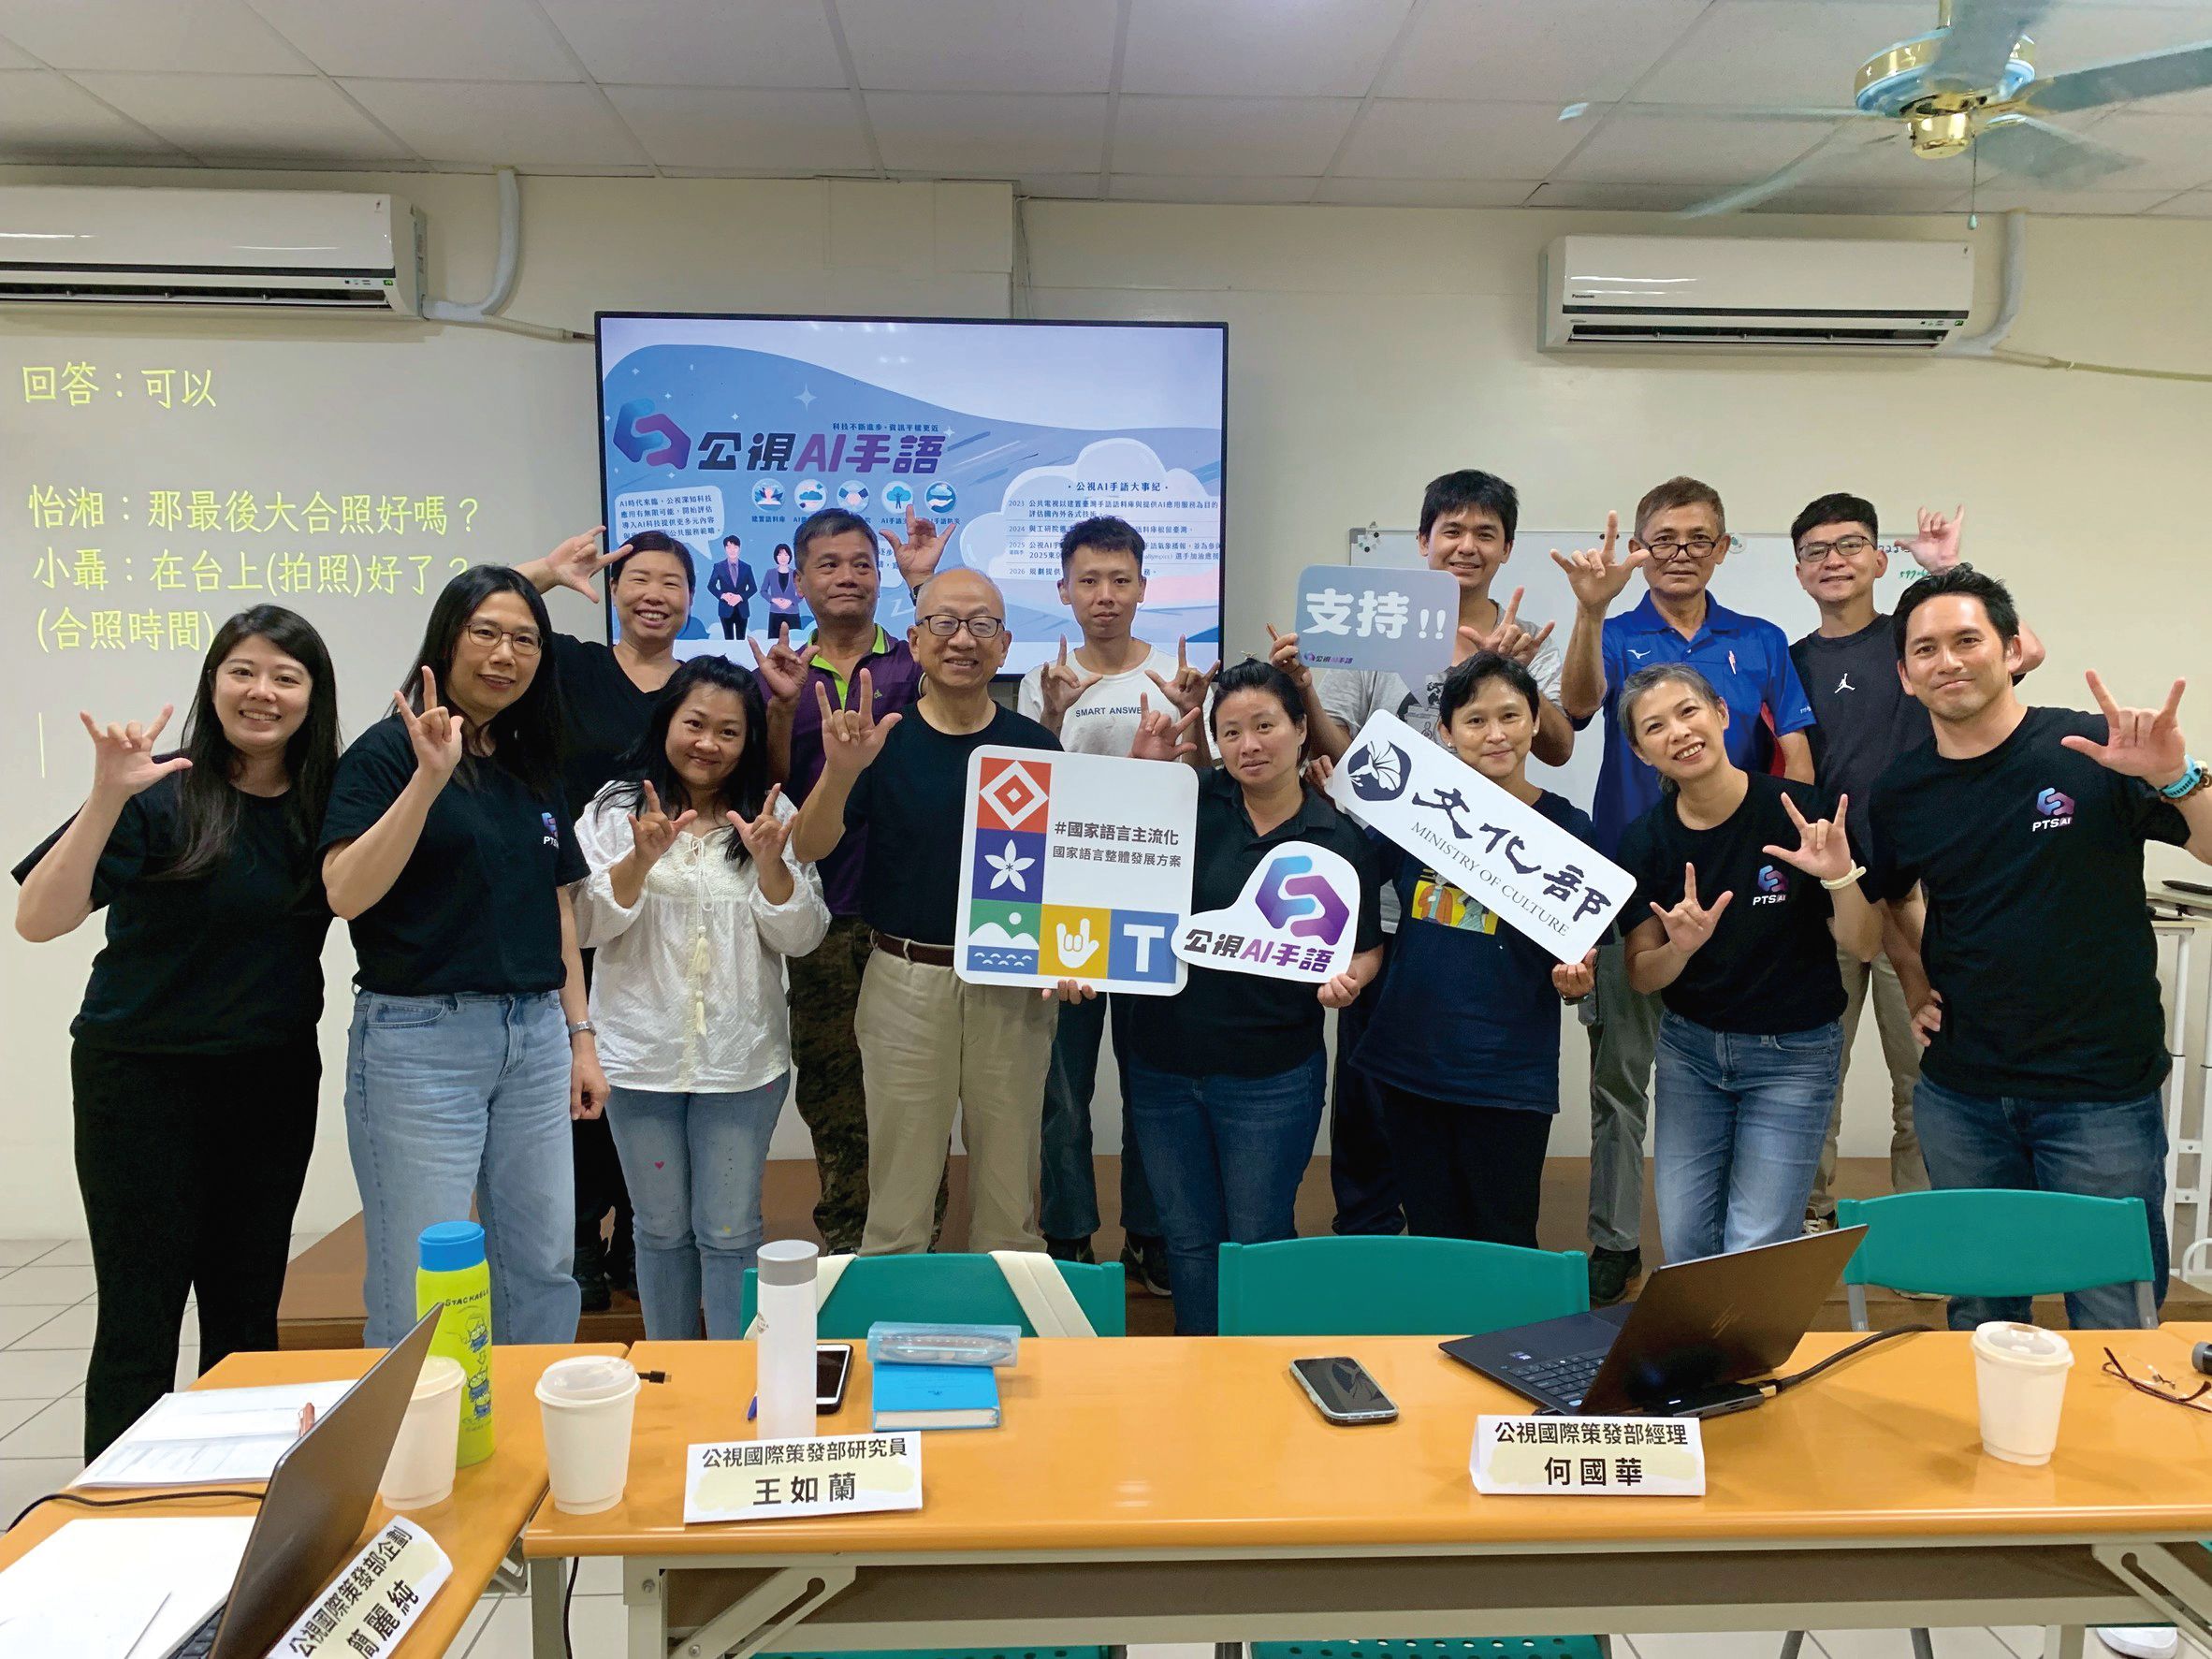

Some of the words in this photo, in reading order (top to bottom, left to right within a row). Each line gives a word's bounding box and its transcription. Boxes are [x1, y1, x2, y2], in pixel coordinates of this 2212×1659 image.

[21, 360, 218, 409] 回答：可以
[697, 431, 946, 474] 公視AI手語
[28, 485, 480, 536] 怡湘：那最後大合照好嗎？
[1075, 706, 1106, 718] SMART
[1054, 822, 1179, 846] #國家語言主流化
[1052, 845, 1182, 868] 國家語言整體發展方案
[1411, 788, 1611, 922] 文化部
[1410, 821, 1480, 873] MINISTRY
[1479, 867, 1503, 888] OF
[1501, 884, 1570, 937] CULTURE
[1183, 928, 1335, 973] 公視AI手語
[702, 1437, 908, 1468] 公視國際策發部研究員
[1494, 1421, 1689, 1446] 公視國際策發部經理
[752, 1472, 856, 1506] 王如蘭
[1544, 1456, 1643, 1487] 何國華
[288, 1525, 413, 1658] 公視國際策發部企劃
